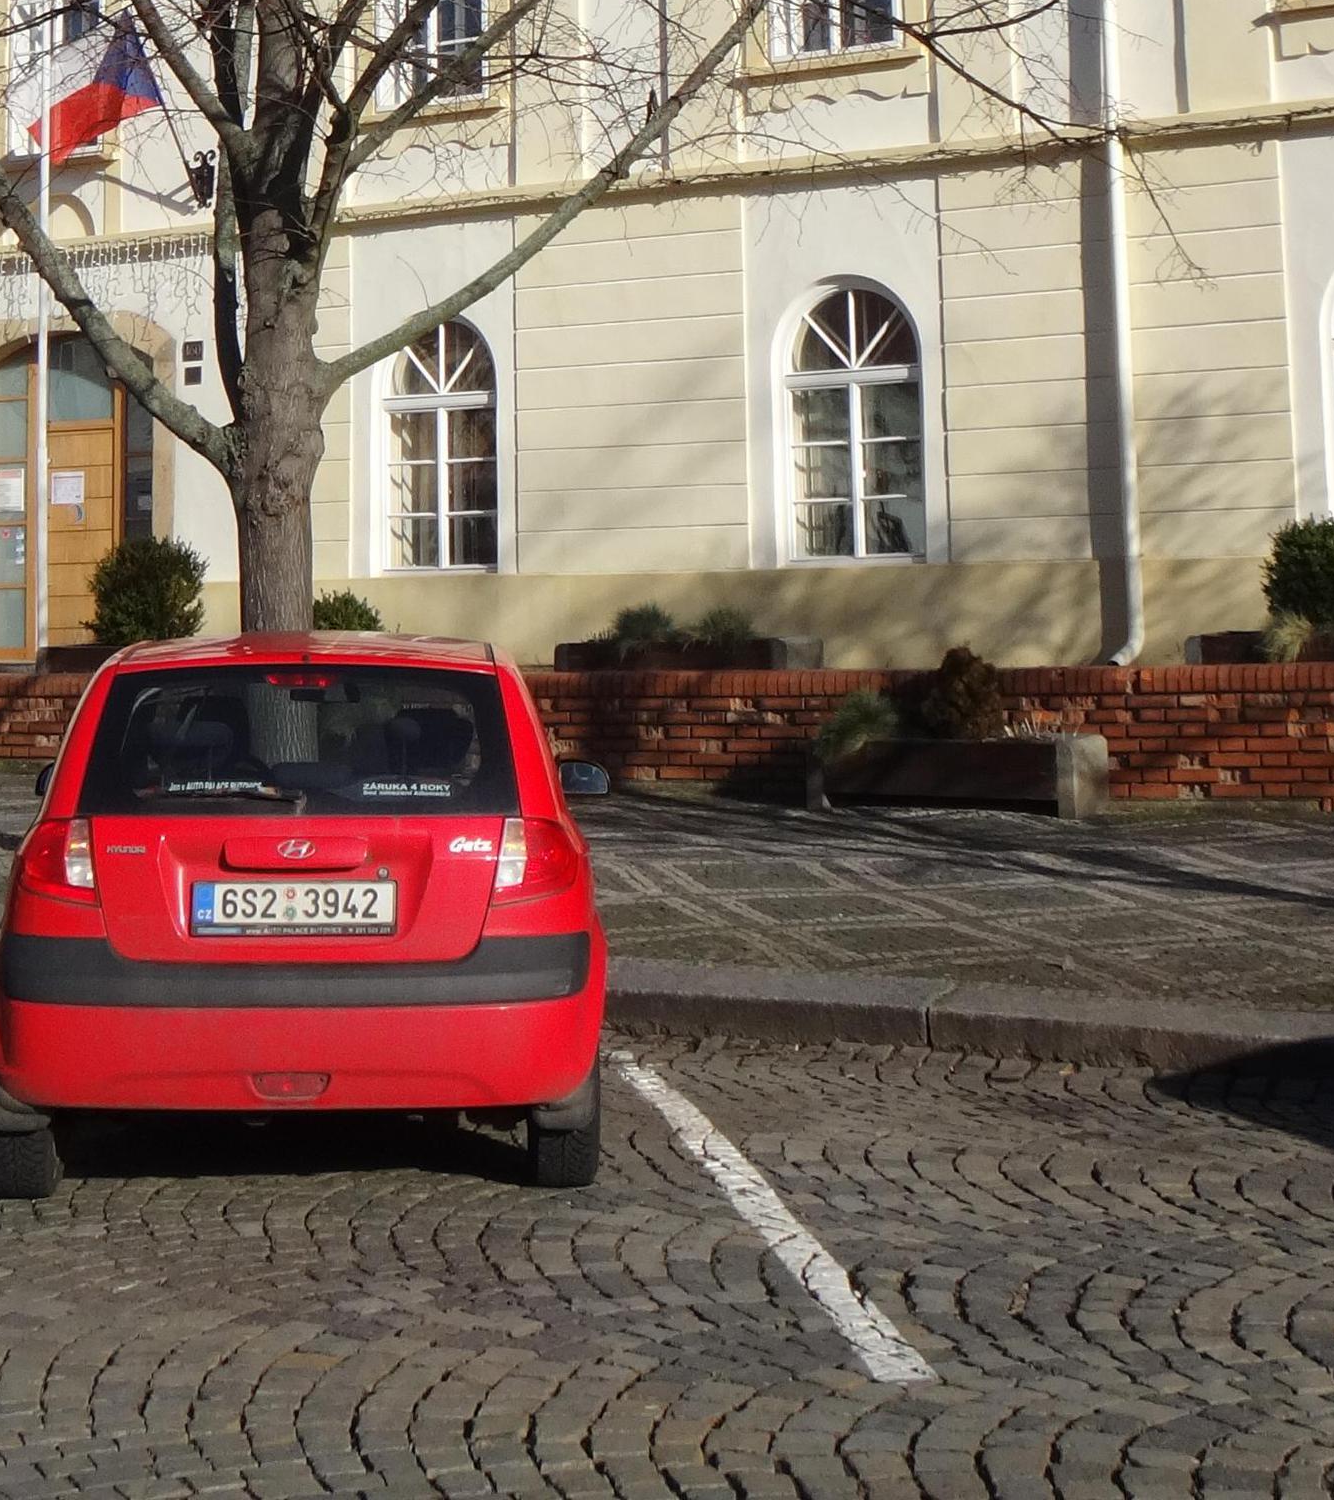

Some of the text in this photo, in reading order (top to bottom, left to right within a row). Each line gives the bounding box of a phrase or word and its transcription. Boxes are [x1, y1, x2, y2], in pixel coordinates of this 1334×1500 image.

[363, 782, 407, 790] ZÁRUKA
[420, 783, 451, 791] ROKY
[449, 836, 492, 852] Getz
[221, 888, 379, 918] 6S2 3942
[197, 910, 213, 920] CZ
